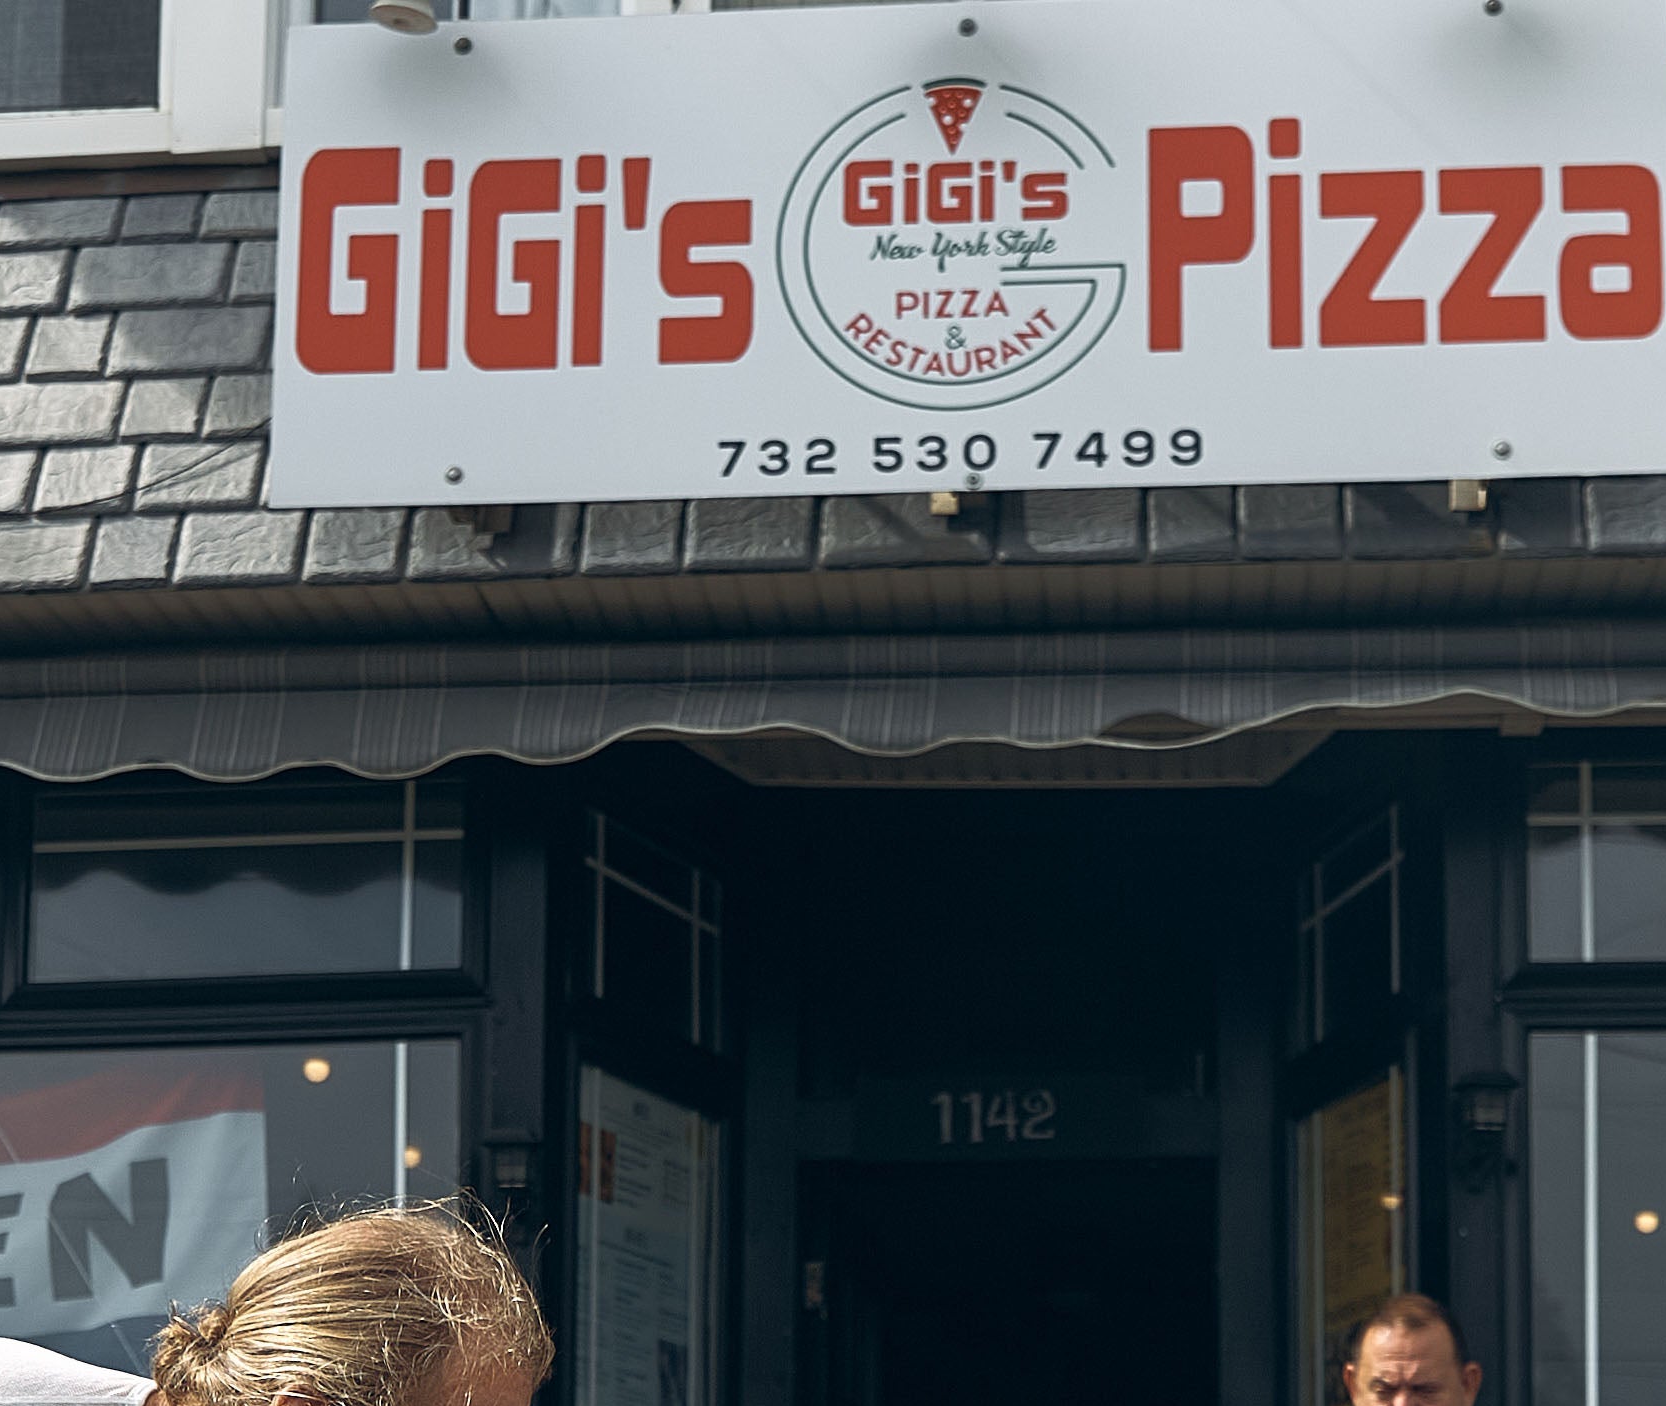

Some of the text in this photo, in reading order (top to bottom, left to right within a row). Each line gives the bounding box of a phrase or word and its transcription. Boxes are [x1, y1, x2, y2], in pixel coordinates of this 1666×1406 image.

[843, 160, 1069, 227] GiGi's
[295, 116, 1665, 375] GiGi's Pizza
[870, 227, 1057, 273] New York Style
[895, 290, 1009, 320] PIZZA
[844, 308, 1057, 377] RESTAURANT
[944, 325, 967, 350] &
[717, 429, 1203, 477] 732 530 7499
[932, 1089, 1057, 1145] 1142
